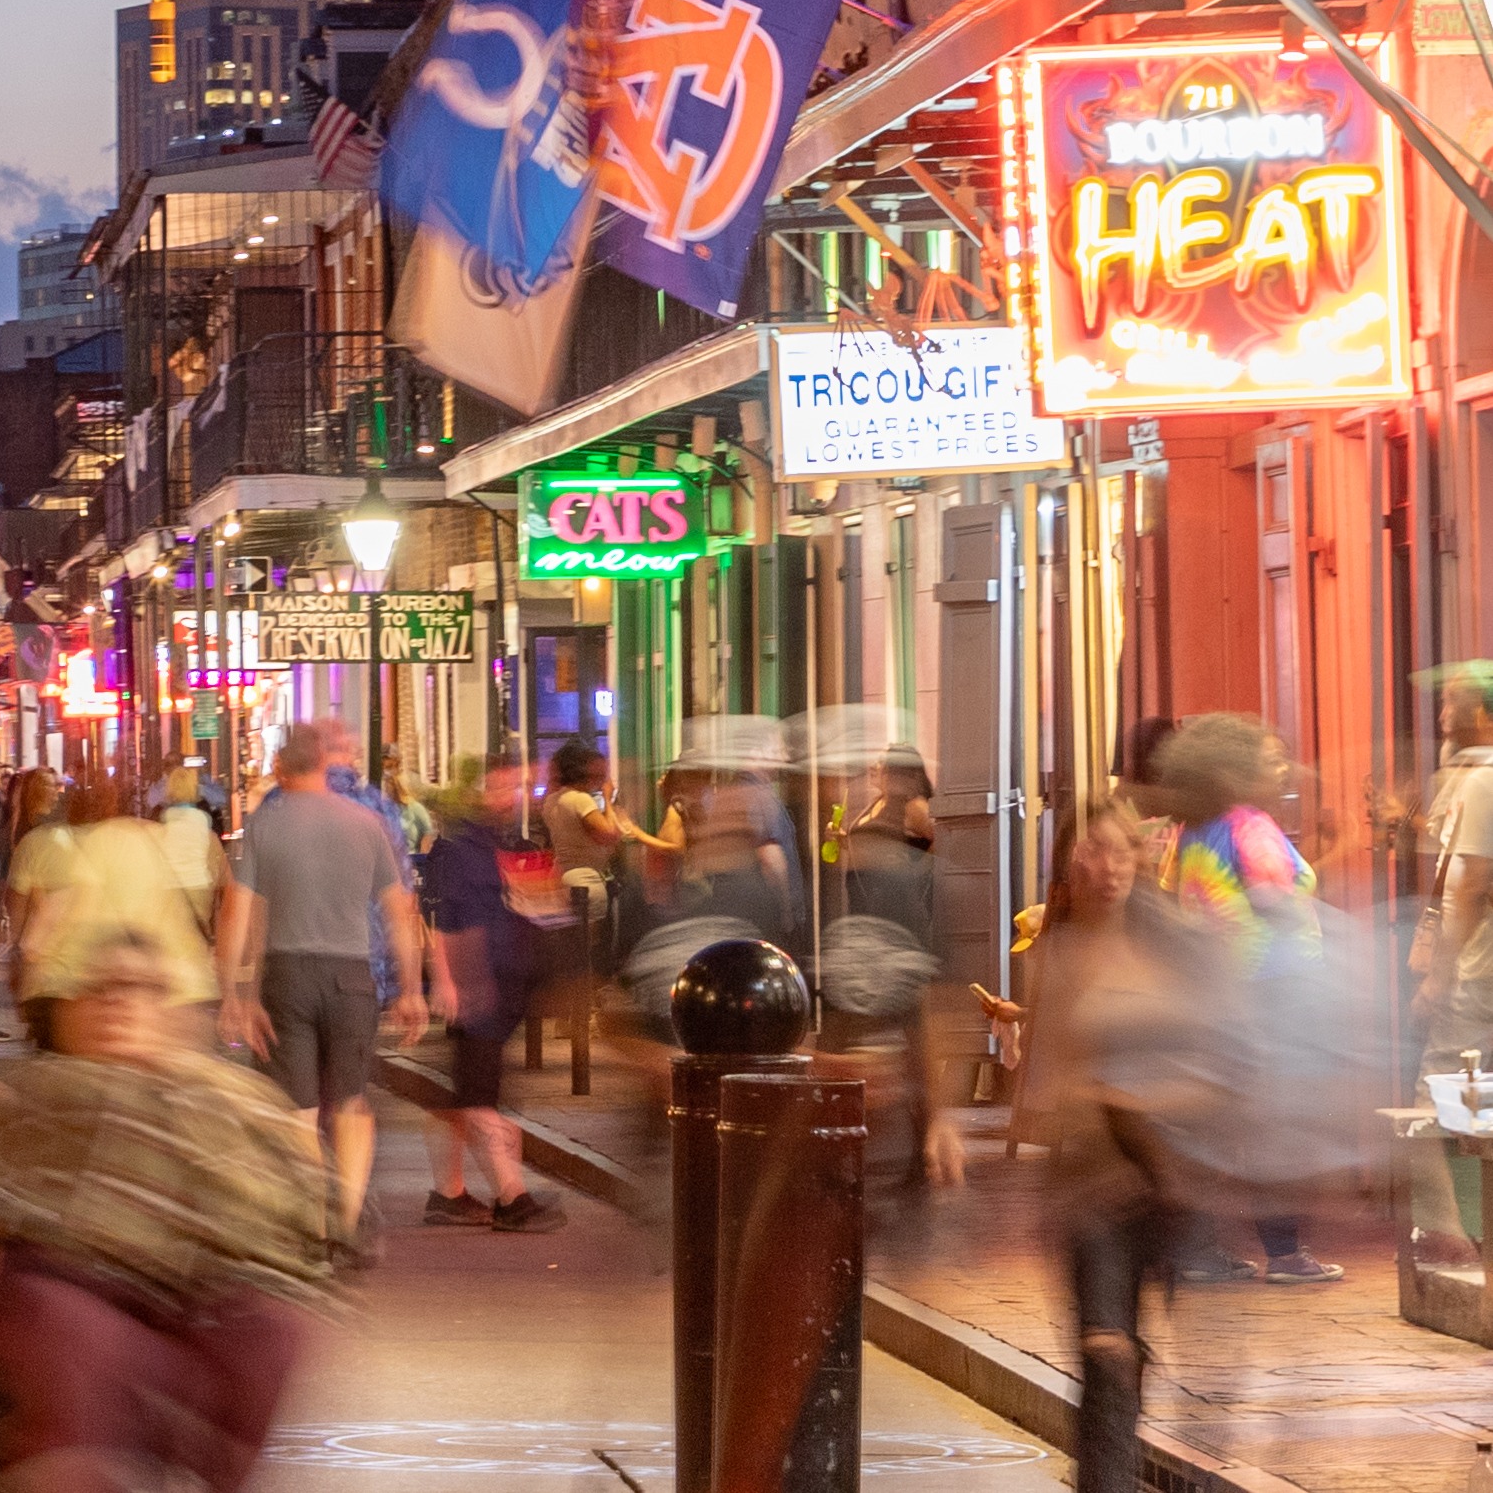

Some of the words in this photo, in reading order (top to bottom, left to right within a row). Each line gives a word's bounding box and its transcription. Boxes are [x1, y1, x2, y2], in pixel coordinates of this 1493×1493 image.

[1183, 83, 1235, 112] 711
[1104, 113, 1325, 164] BOURBON
[1071, 165, 1382, 339] HEAT
[788, 368, 926, 408] TRICOU
[944, 364, 1022, 400] GIF
[824, 411, 1018, 439] GUARANTEED
[805, 440, 920, 463] LOWEST
[937, 433, 1039, 455] PRICES
[548, 490, 688, 544] CATS
[534, 549, 701, 571] meow
[261, 594, 350, 612] MAISON
[278, 612, 370, 627] DEDICATED
[380, 612, 407, 627] TO
[418, 612, 456, 627] THE
[258, 616, 412, 661] PRESERVATON
[417, 615, 473, 661] JAZZ
